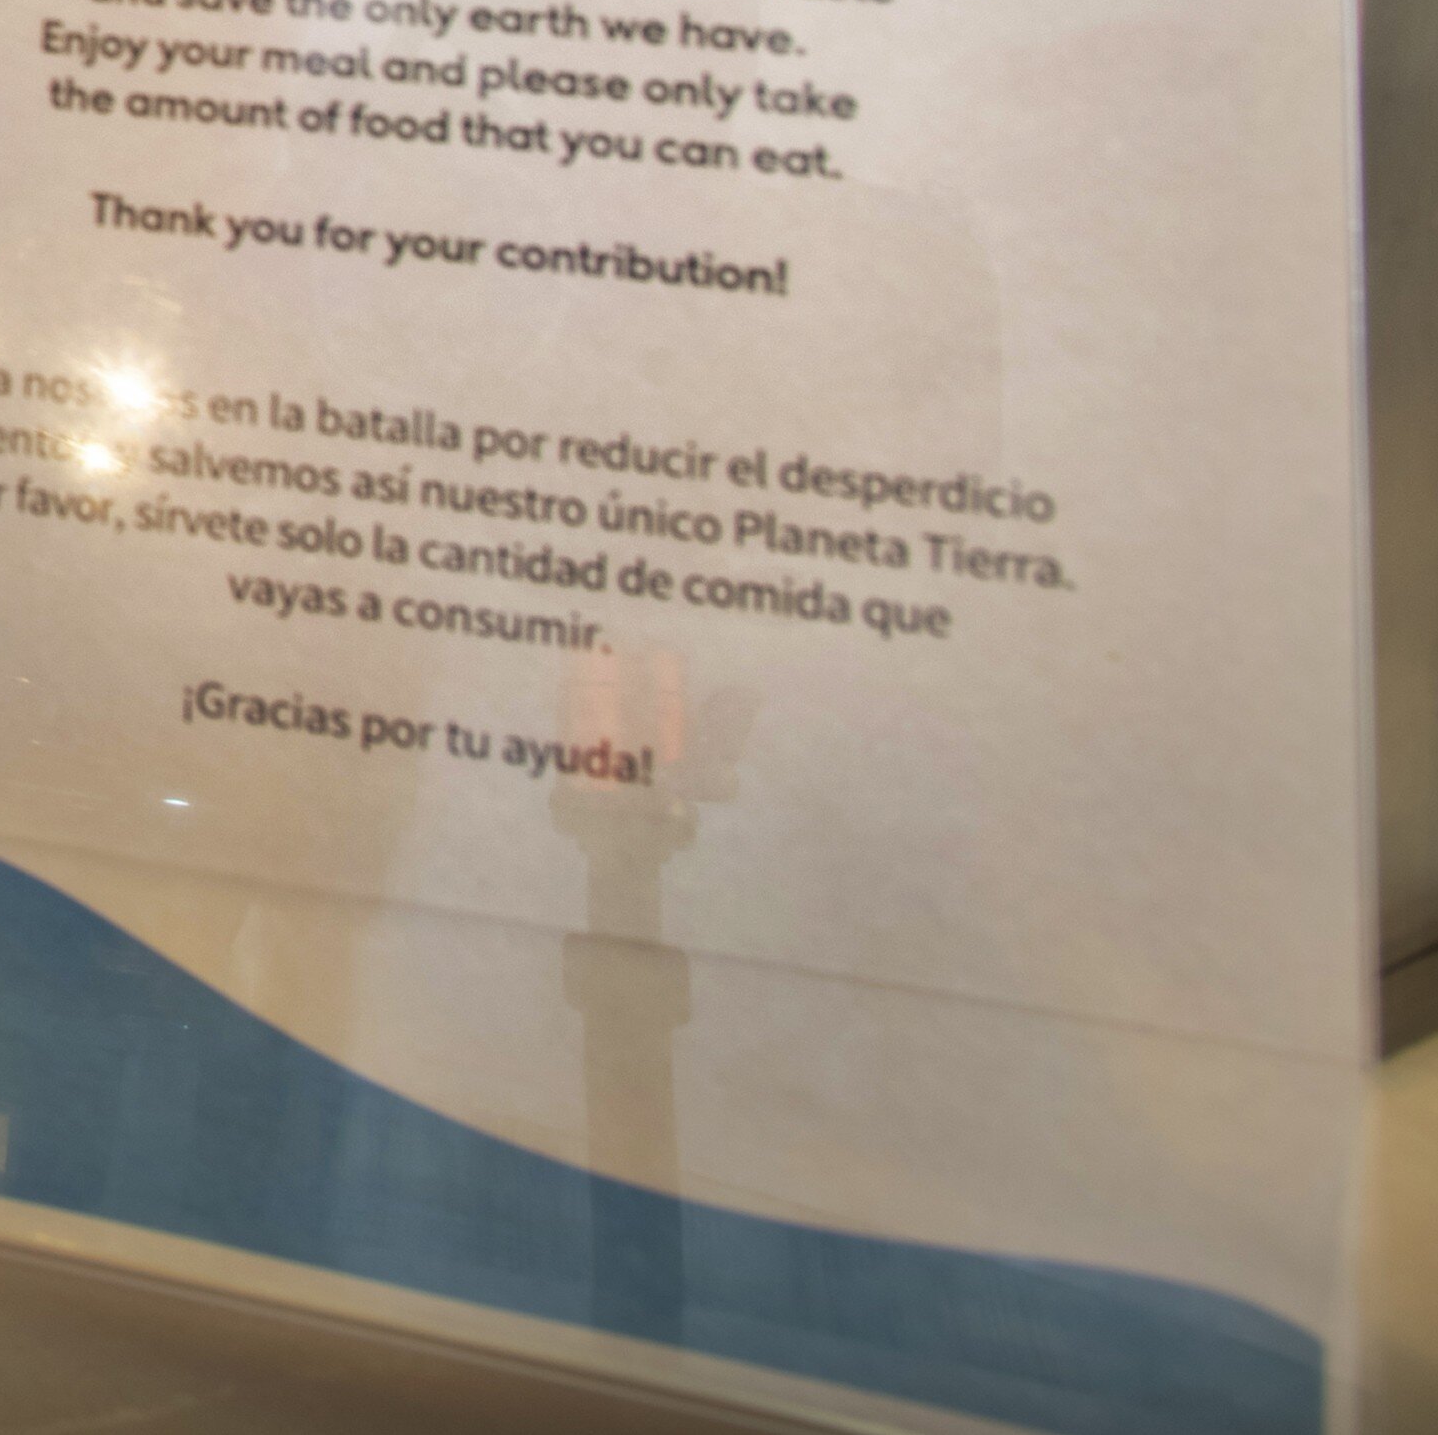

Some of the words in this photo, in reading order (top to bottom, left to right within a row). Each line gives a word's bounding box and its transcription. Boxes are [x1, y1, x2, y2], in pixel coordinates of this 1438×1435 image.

[40, 17, 148, 70] Enjoy
[157, 42, 252, 73] your
[261, 46, 372, 80] meal
[381, 53, 466, 88] and
[477, 57, 632, 101] please
[642, 70, 744, 121] only
[754, 79, 859, 121] take
[468, 2, 589, 39] earth
[600, 14, 667, 46] we
[679, 10, 808, 56] have.
[48, 76, 116, 115] the
[126, 91, 288, 130] amount
[298, 99, 341, 134] of
[349, 102, 451, 145] food
[461, 112, 551, 153] that
[559, 127, 644, 166] you
[654, 136, 739, 169] can
[751, 144, 844, 181] eat.
[89, 191, 216, 238] Thank
[224, 215, 305, 252] you
[314, 213, 375, 254] for
[383, 231, 486, 267] your
[494, 239, 790, 298] contribution!
[207, 390, 258, 426] en
[269, 390, 305, 433] la
[316, 396, 463, 452] batalla
[472, 423, 550, 465] por
[558, 430, 719, 481] reducir
[727, 447, 768, 489] el
[778, 452, 1056, 525] desperdicio
[15, 475, 126, 536] favor,
[133, 491, 271, 548] sírvete
[276, 515, 364, 560] solo
[372, 521, 410, 565] la
[418, 540, 609, 594] cantidad
[617, 557, 675, 602] de
[681, 574, 853, 626] comida
[861, 595, 954, 642] que
[148, 440, 342, 498] salvemos
[350, 464, 413, 506] así
[420, 475, 589, 528] nuestro
[597, 488, 724, 547] único
[733, 507, 911, 569] Planeta
[923, 531, 1077, 591] Tierra.
[227, 571, 348, 620] vayas
[356, 590, 383, 623] a
[391, 595, 615, 656] consumir.
[181, 679, 352, 741] ¡Gracias
[360, 712, 436, 753] por
[446, 720, 492, 762] tu
[501, 734, 656, 788] ayuda!
